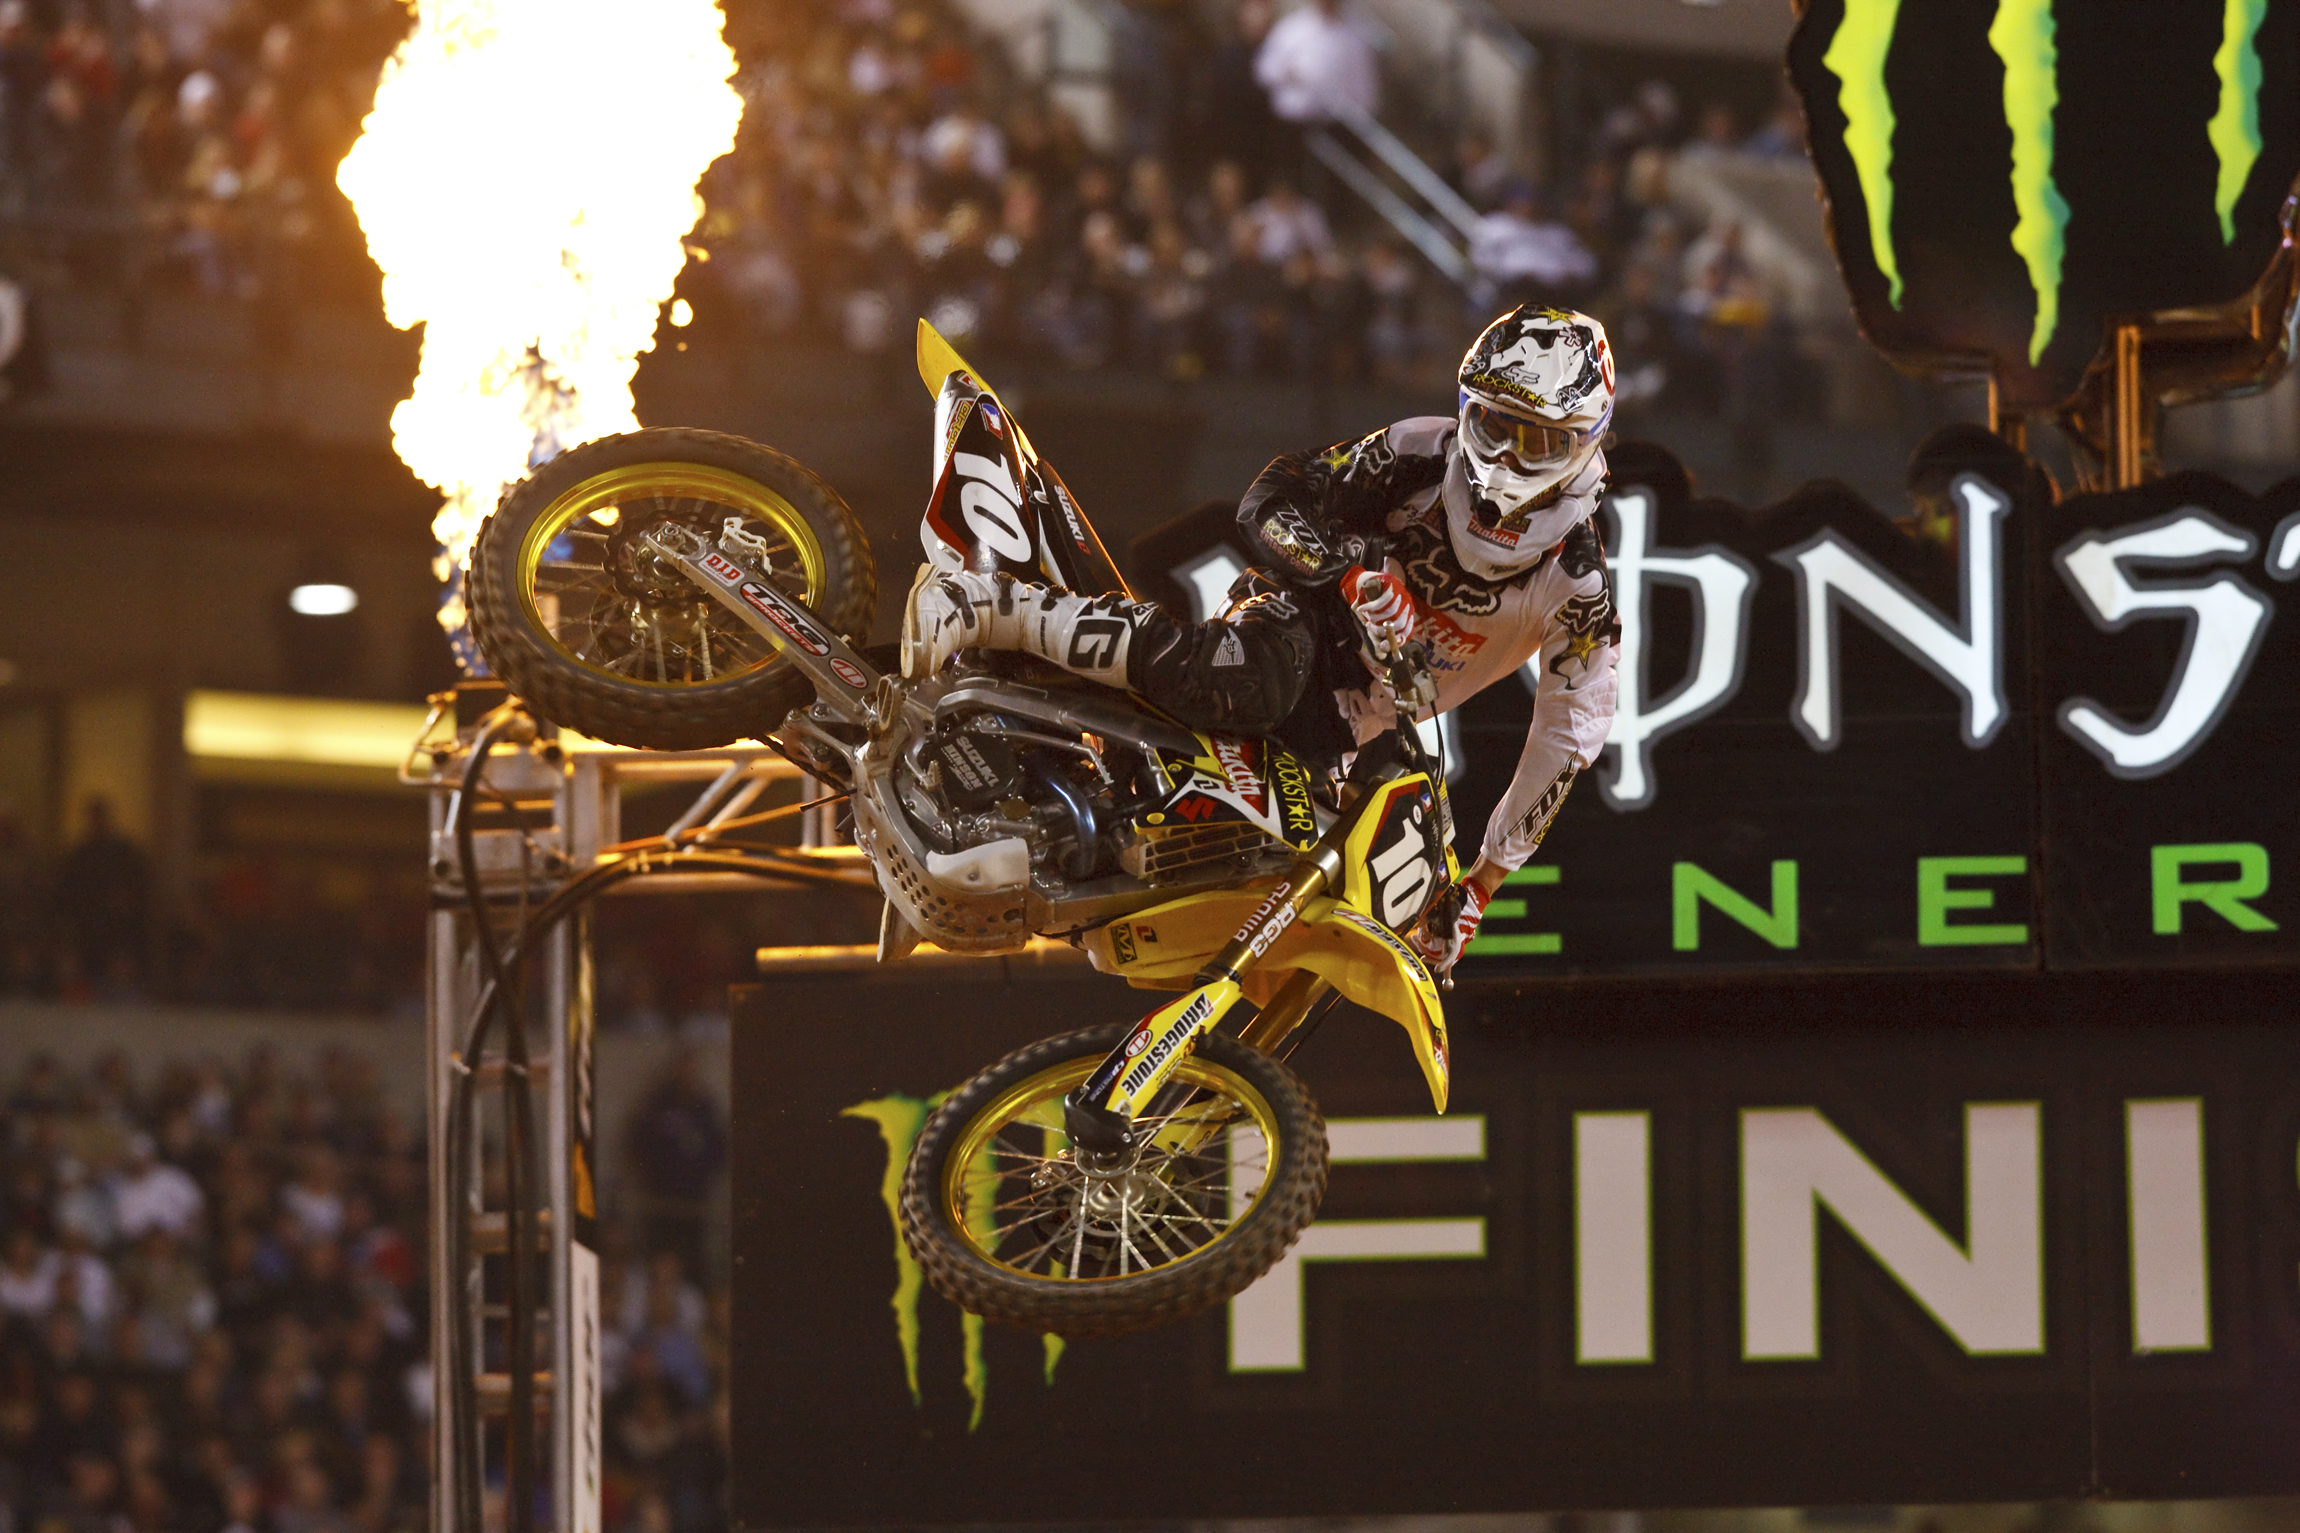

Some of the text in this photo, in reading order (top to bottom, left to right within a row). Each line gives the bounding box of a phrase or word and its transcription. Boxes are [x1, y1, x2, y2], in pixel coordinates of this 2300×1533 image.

[954, 452, 1031, 563] 10
[1054, 485, 1084, 540] SUZUKI
[750, 585, 826, 648] TAG
[1413, 616, 1476, 657] kita
[956, 735, 999, 787] SUZUKI
[1371, 817, 1432, 928] 10
[1234, 882, 1291, 942] SHOWA
[1249, 902, 1297, 958] RG3
[1121, 992, 1214, 1097] BRIDGESTONE
[1228, 1098, 2300, 1372] FINI
